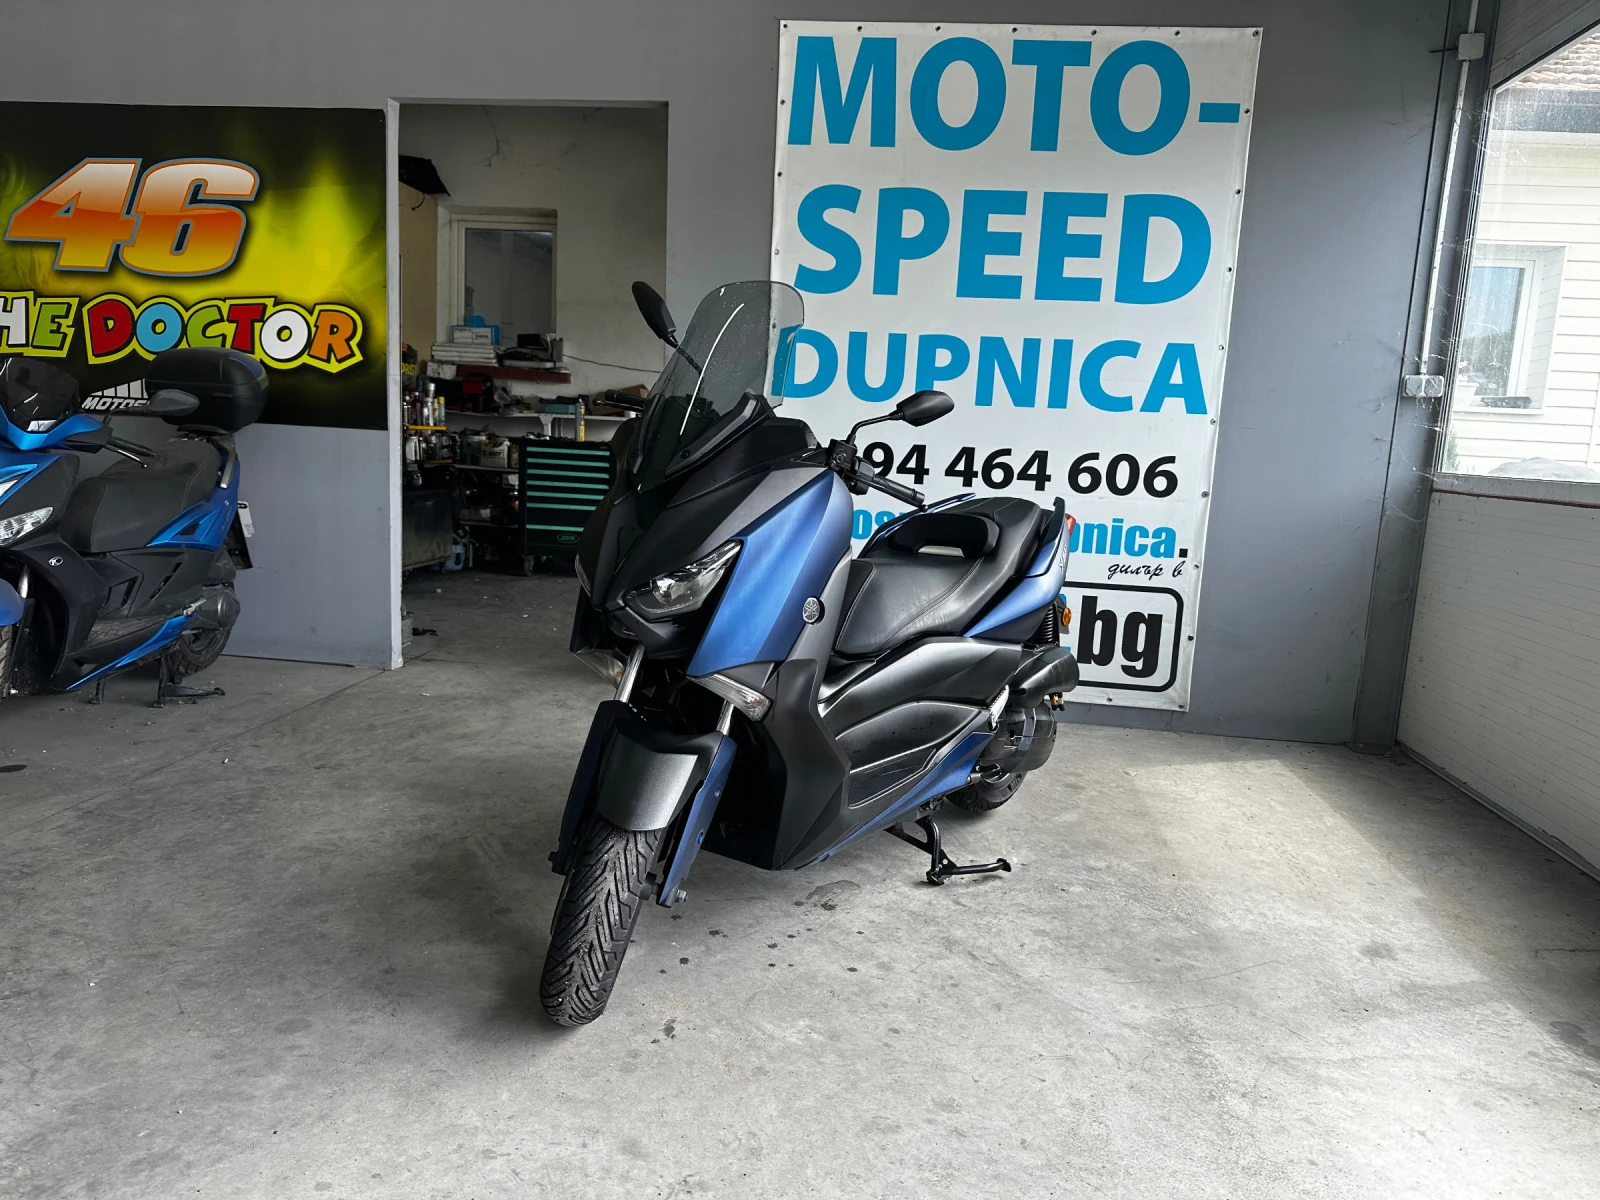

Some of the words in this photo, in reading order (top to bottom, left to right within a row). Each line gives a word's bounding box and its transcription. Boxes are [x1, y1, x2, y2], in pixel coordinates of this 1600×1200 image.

[787, 36, 1241, 156] MOTO-
[4, 157, 260, 277] 46
[793, 184, 1212, 305] SPEED
[84, 295, 361, 368] DOCTOR
[771, 325, 1208, 416] DUPNICA
[944, 446, 1052, 492] 464
[1067, 452, 1178, 498] 606
